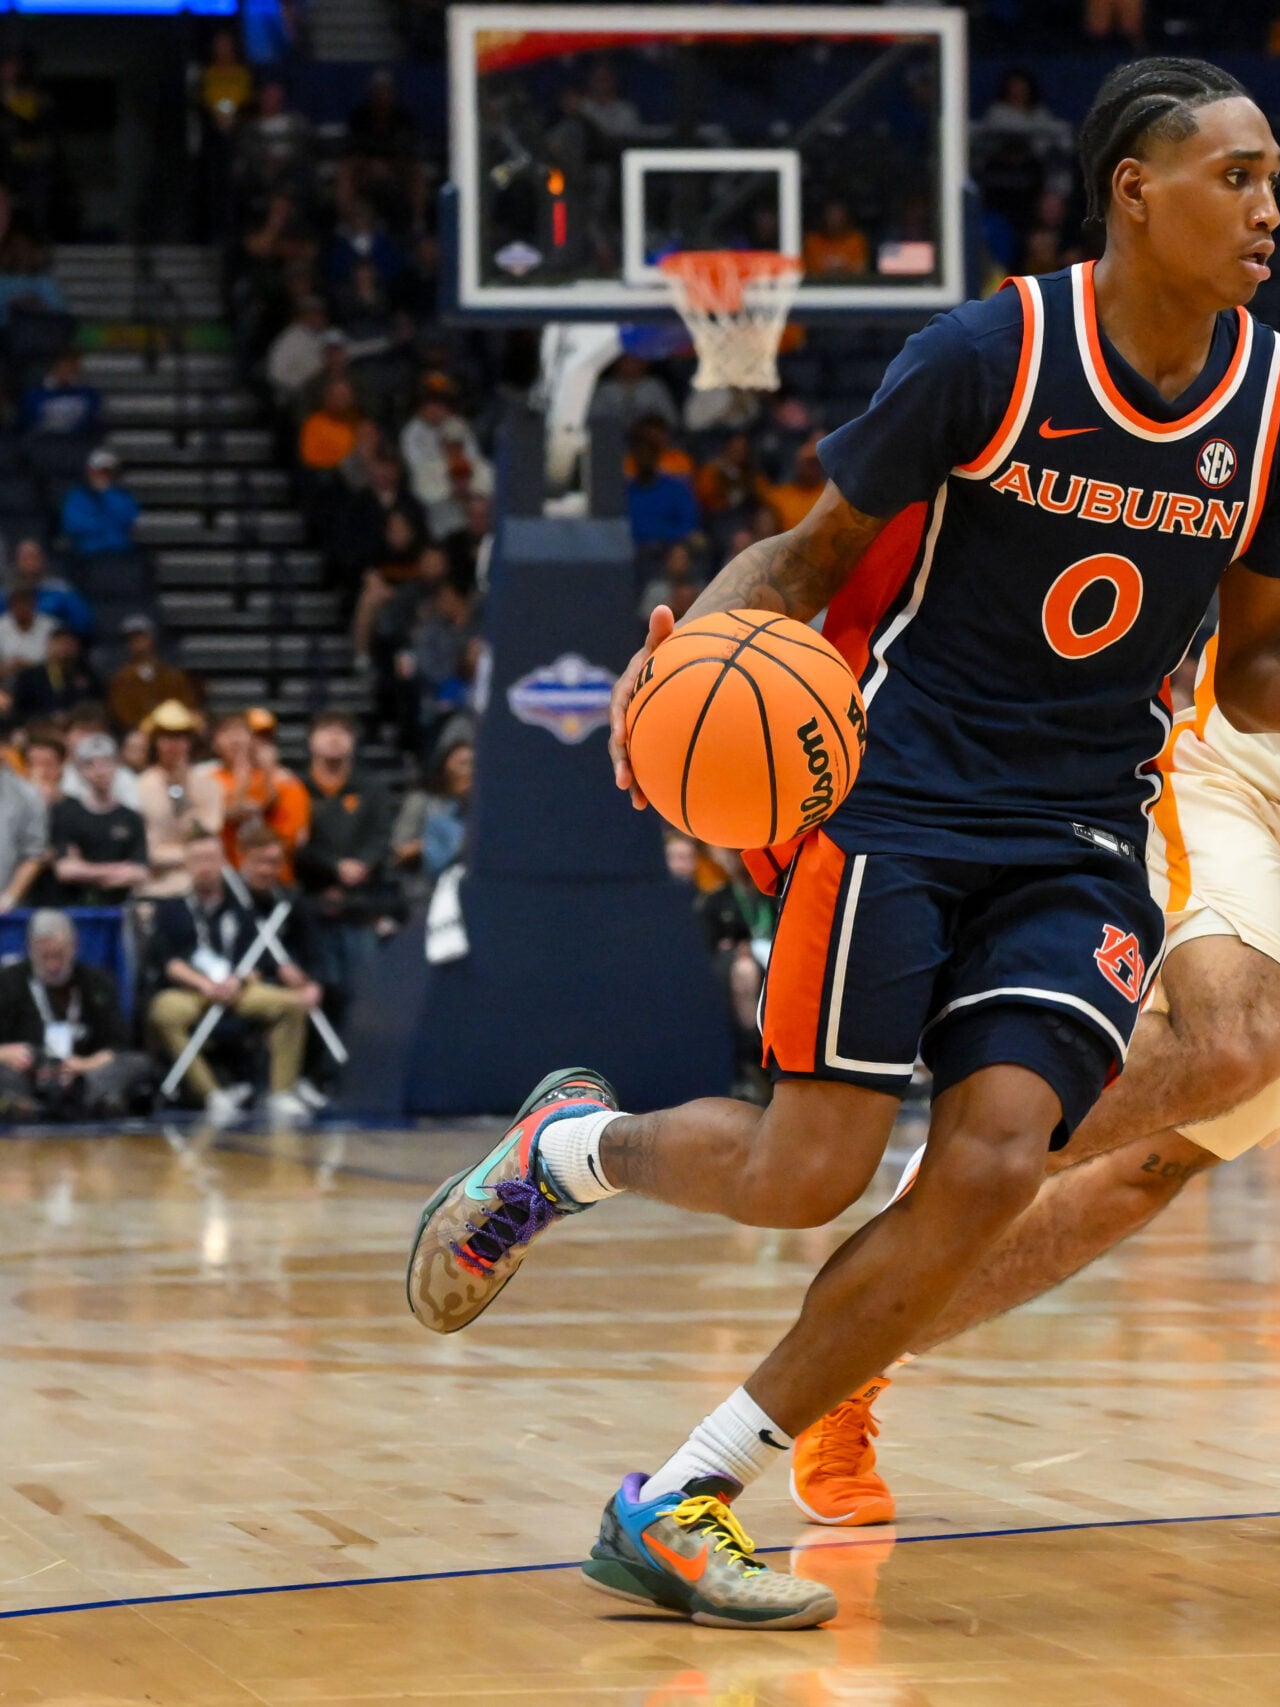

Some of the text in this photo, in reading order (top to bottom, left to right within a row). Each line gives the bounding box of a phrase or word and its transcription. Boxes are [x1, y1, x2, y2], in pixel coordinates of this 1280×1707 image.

[990, 461, 1244, 539] AUBURN
[1199, 442, 1235, 484] SEC
[1042, 553, 1144, 660] 0
